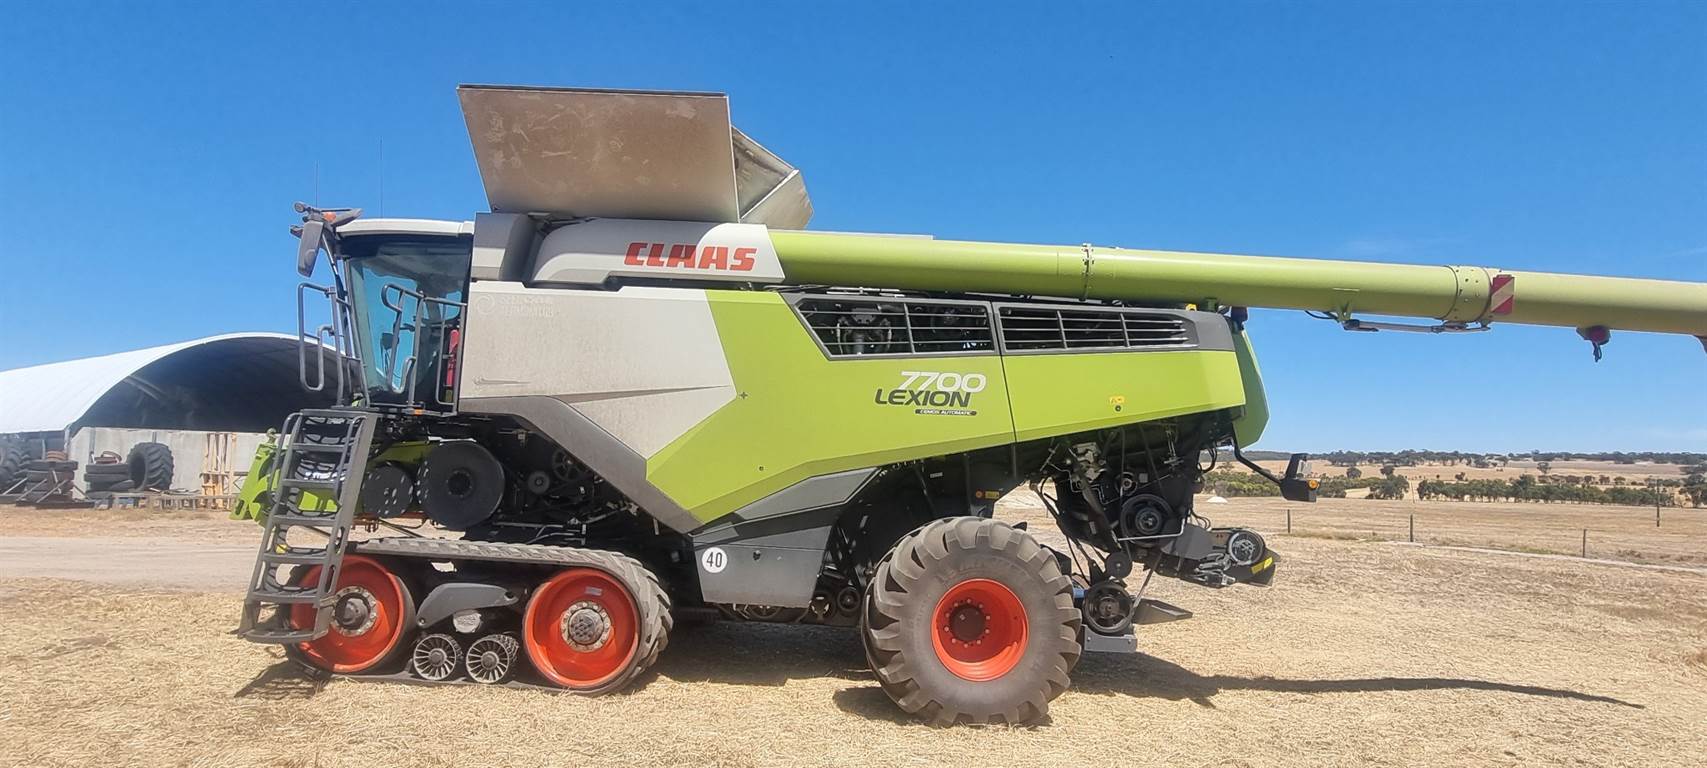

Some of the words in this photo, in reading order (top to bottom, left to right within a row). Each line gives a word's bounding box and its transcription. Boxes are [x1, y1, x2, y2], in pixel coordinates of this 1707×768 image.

[624, 242, 757, 271] CLAAS
[898, 371, 987, 393] 7700
[875, 388, 971, 408] LEXION
[706, 552, 723, 568] 40
